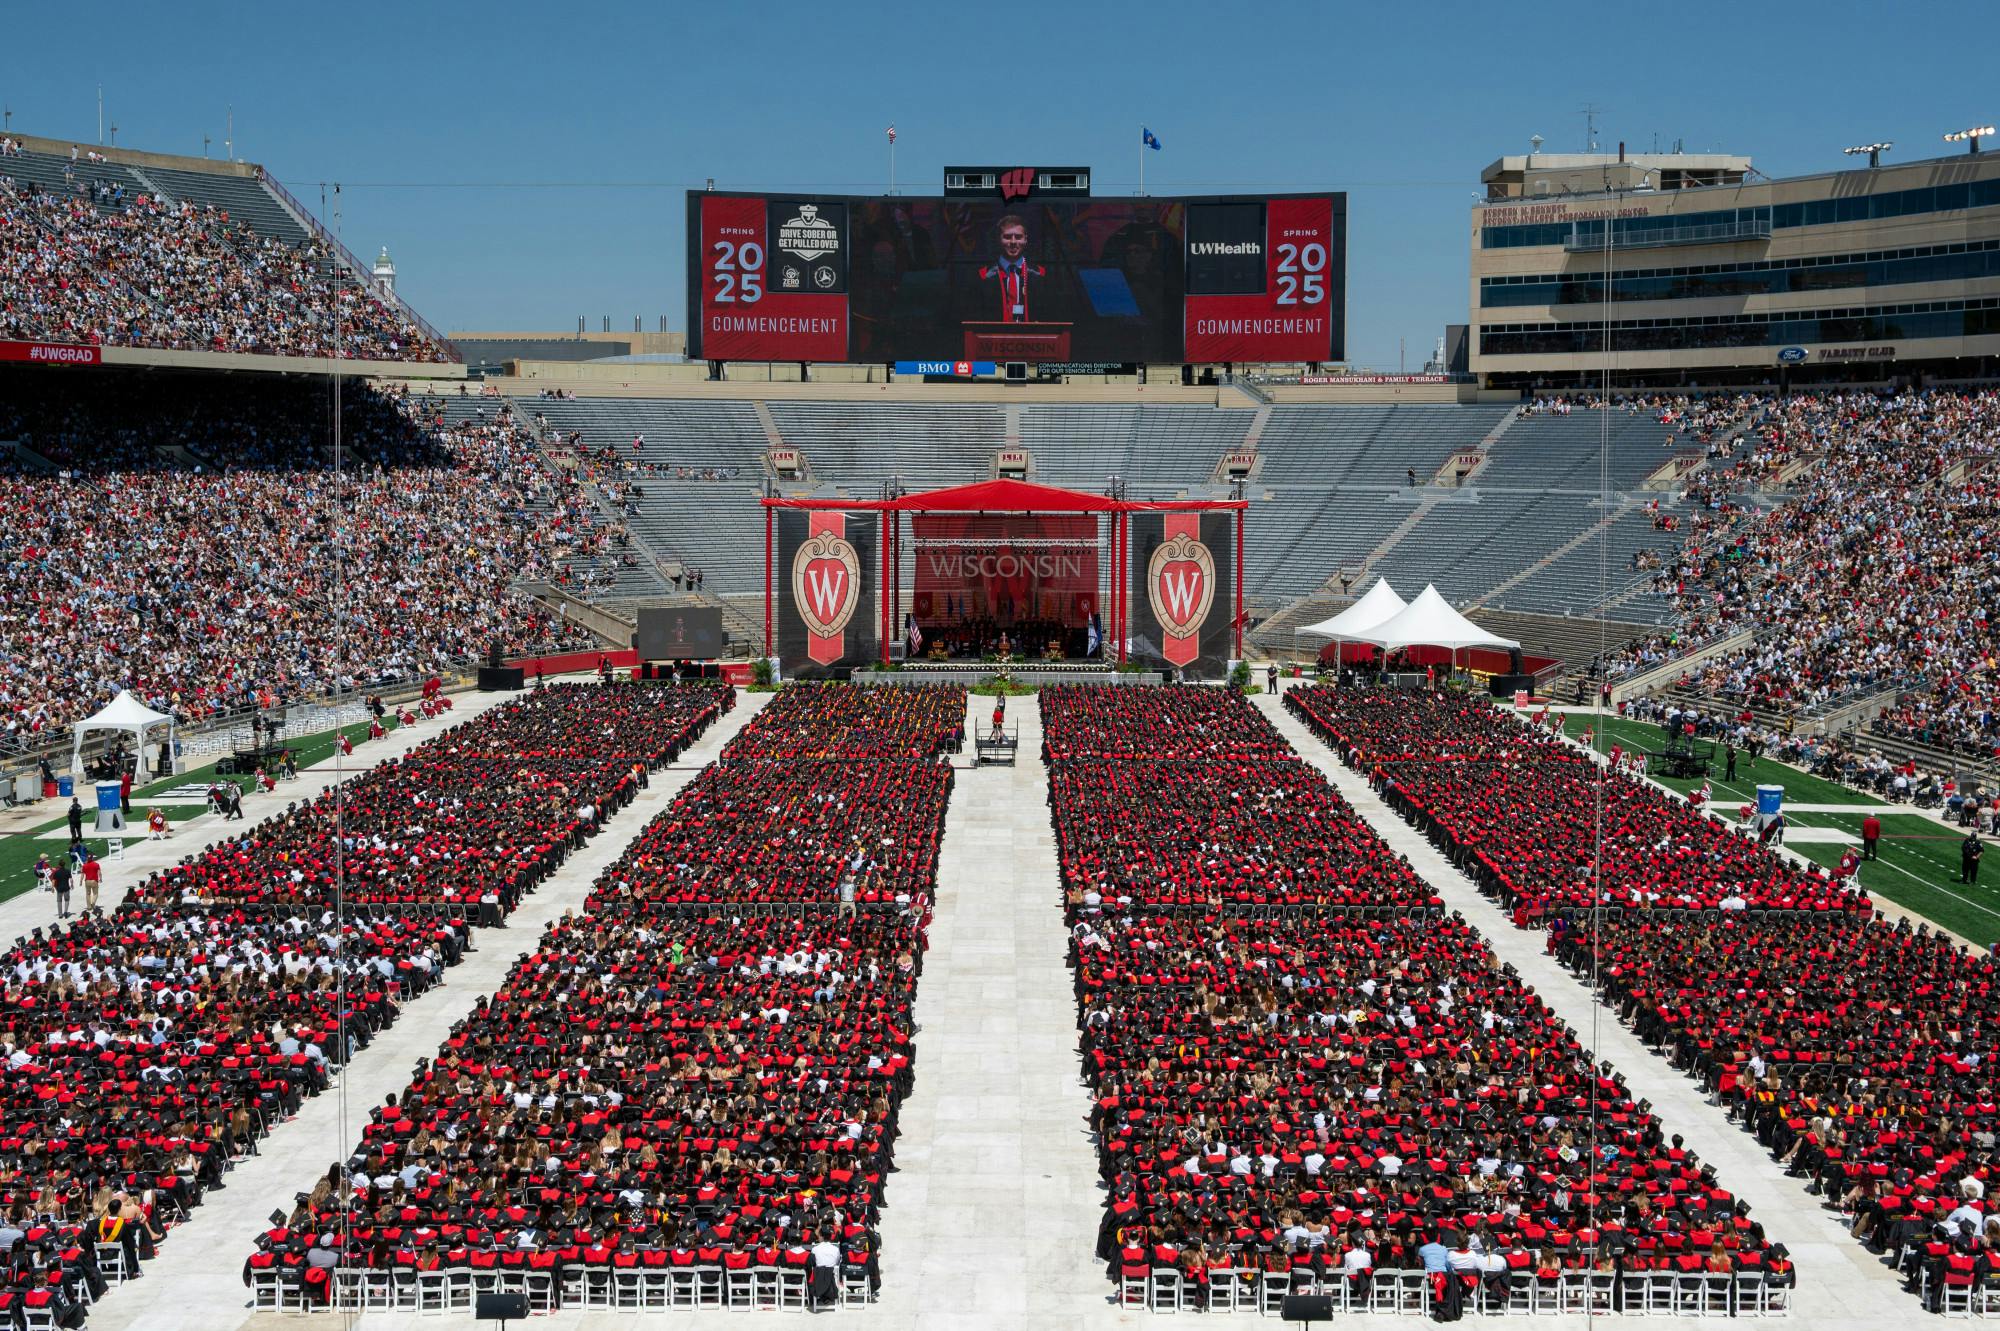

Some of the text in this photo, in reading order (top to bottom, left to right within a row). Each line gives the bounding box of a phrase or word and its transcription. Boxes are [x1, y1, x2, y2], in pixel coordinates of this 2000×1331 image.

[720, 227, 754, 235] SPRING
[780, 229, 837, 239] DRIVE SOBER OR
[1284, 229, 1318, 237] SPRING
[778, 239, 839, 249] GET PULLED OVER
[714, 241, 763, 271] 20
[1277, 243, 1326, 272] 20
[714, 273, 762, 302] 25
[1277, 275, 1325, 304] 25
[713, 316, 838, 333] COMMENCEMENT
[1198, 319, 1322, 335] COMMENCEMENT
[30, 346, 93, 362] #UWGRAD
[1783, 350, 1801, 360] Ford
[1819, 346, 1896, 358] VARSITY CLUB
[918, 363, 950, 374] BMO
[1303, 376, 1328, 384] ROGER
[929, 555, 1081, 578] WISCONSIN
[808, 567, 845, 617] W
[1163, 569, 1200, 618] W
